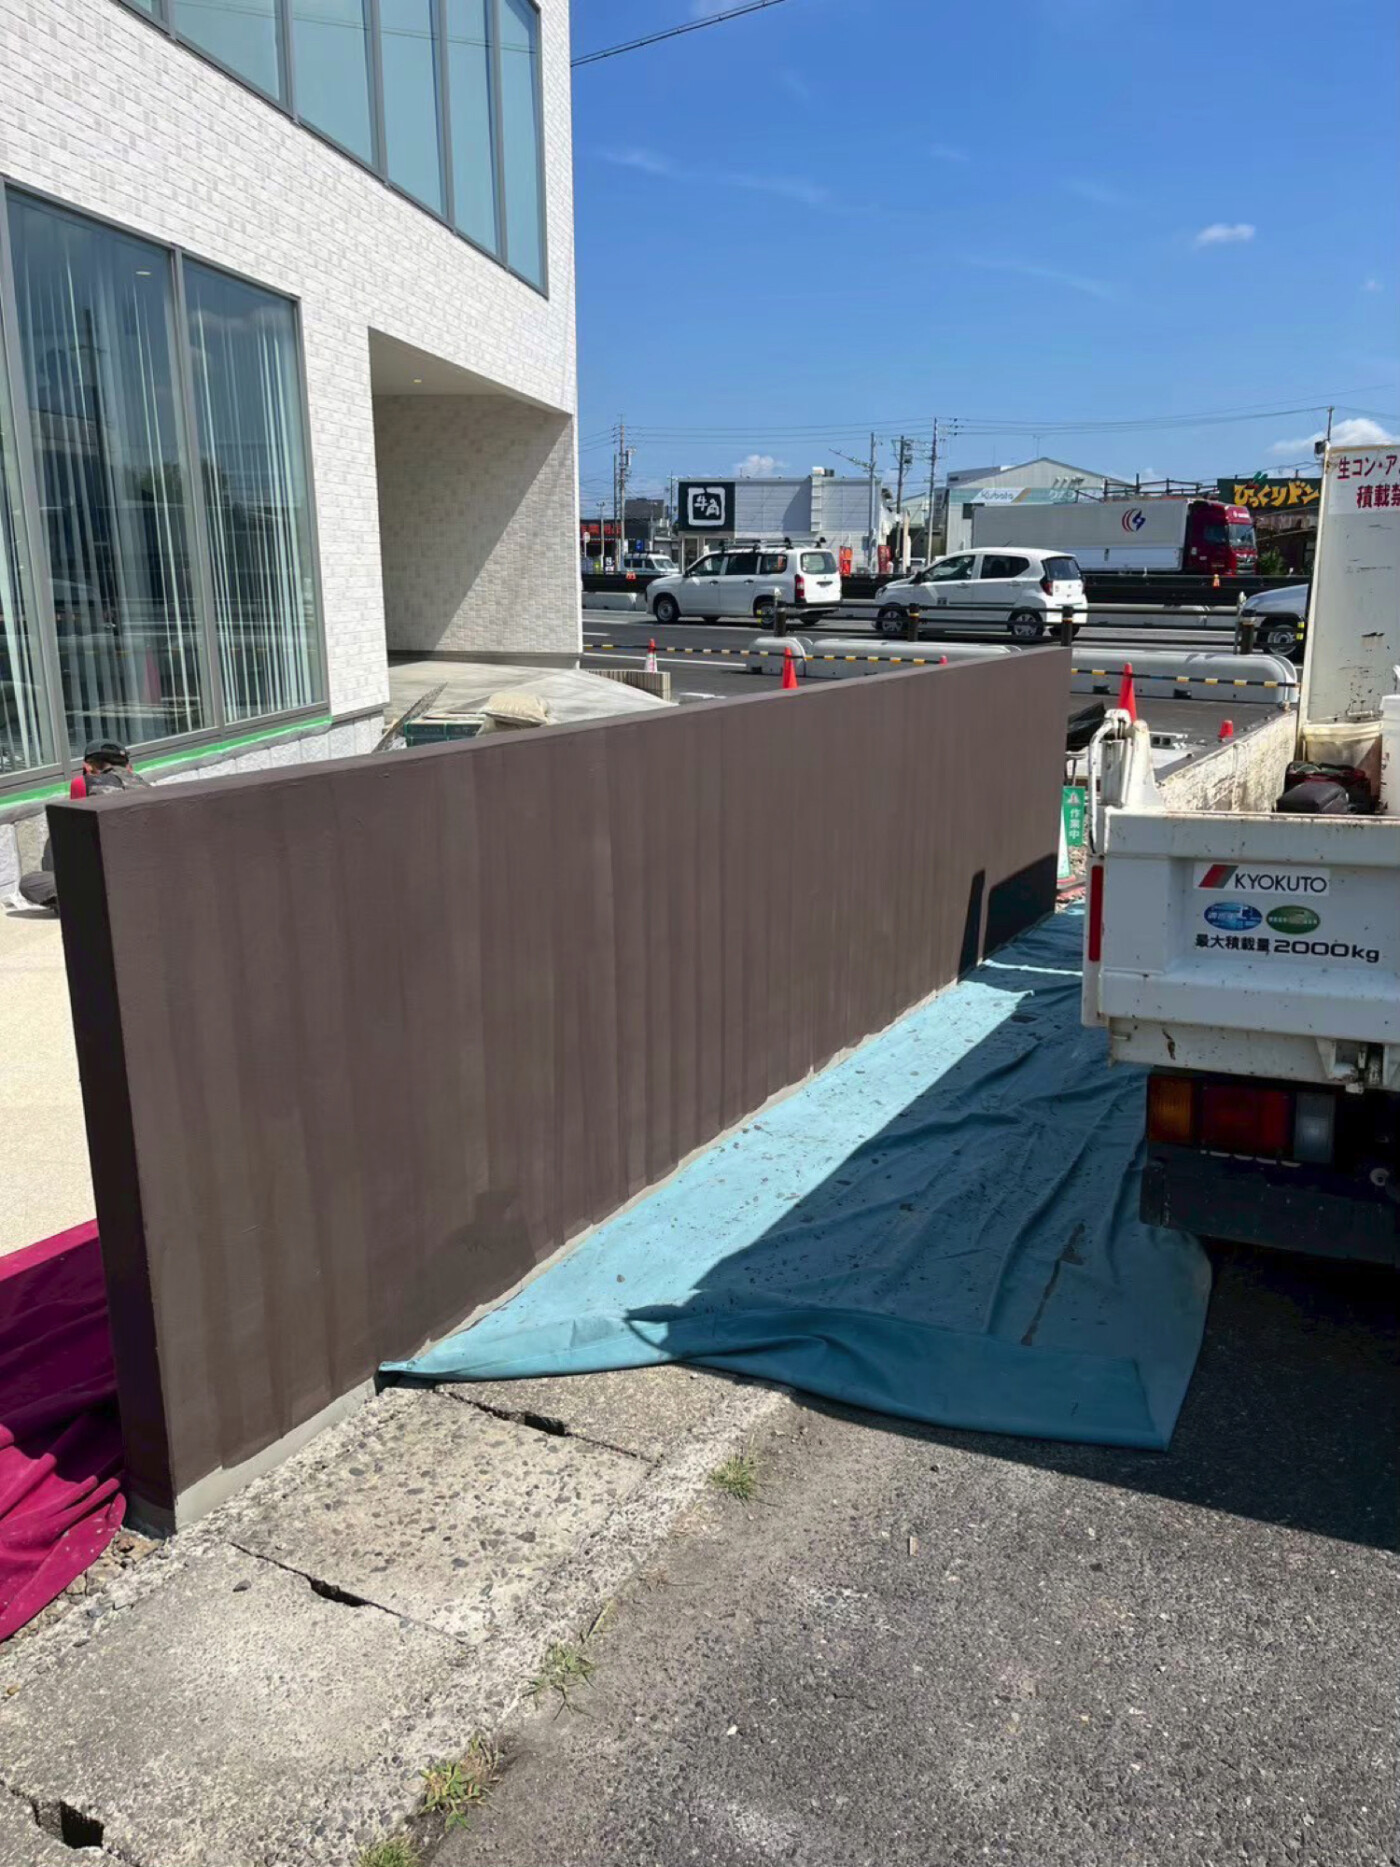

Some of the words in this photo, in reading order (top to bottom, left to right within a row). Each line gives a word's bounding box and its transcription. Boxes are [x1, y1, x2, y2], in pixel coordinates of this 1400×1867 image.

[1338, 455, 1400, 479] 生コン・ア
[694, 494, 720, 516] 牛角
[1068, 808, 1081, 840] 作業中
[1235, 873, 1328, 894] KYOKUTO
